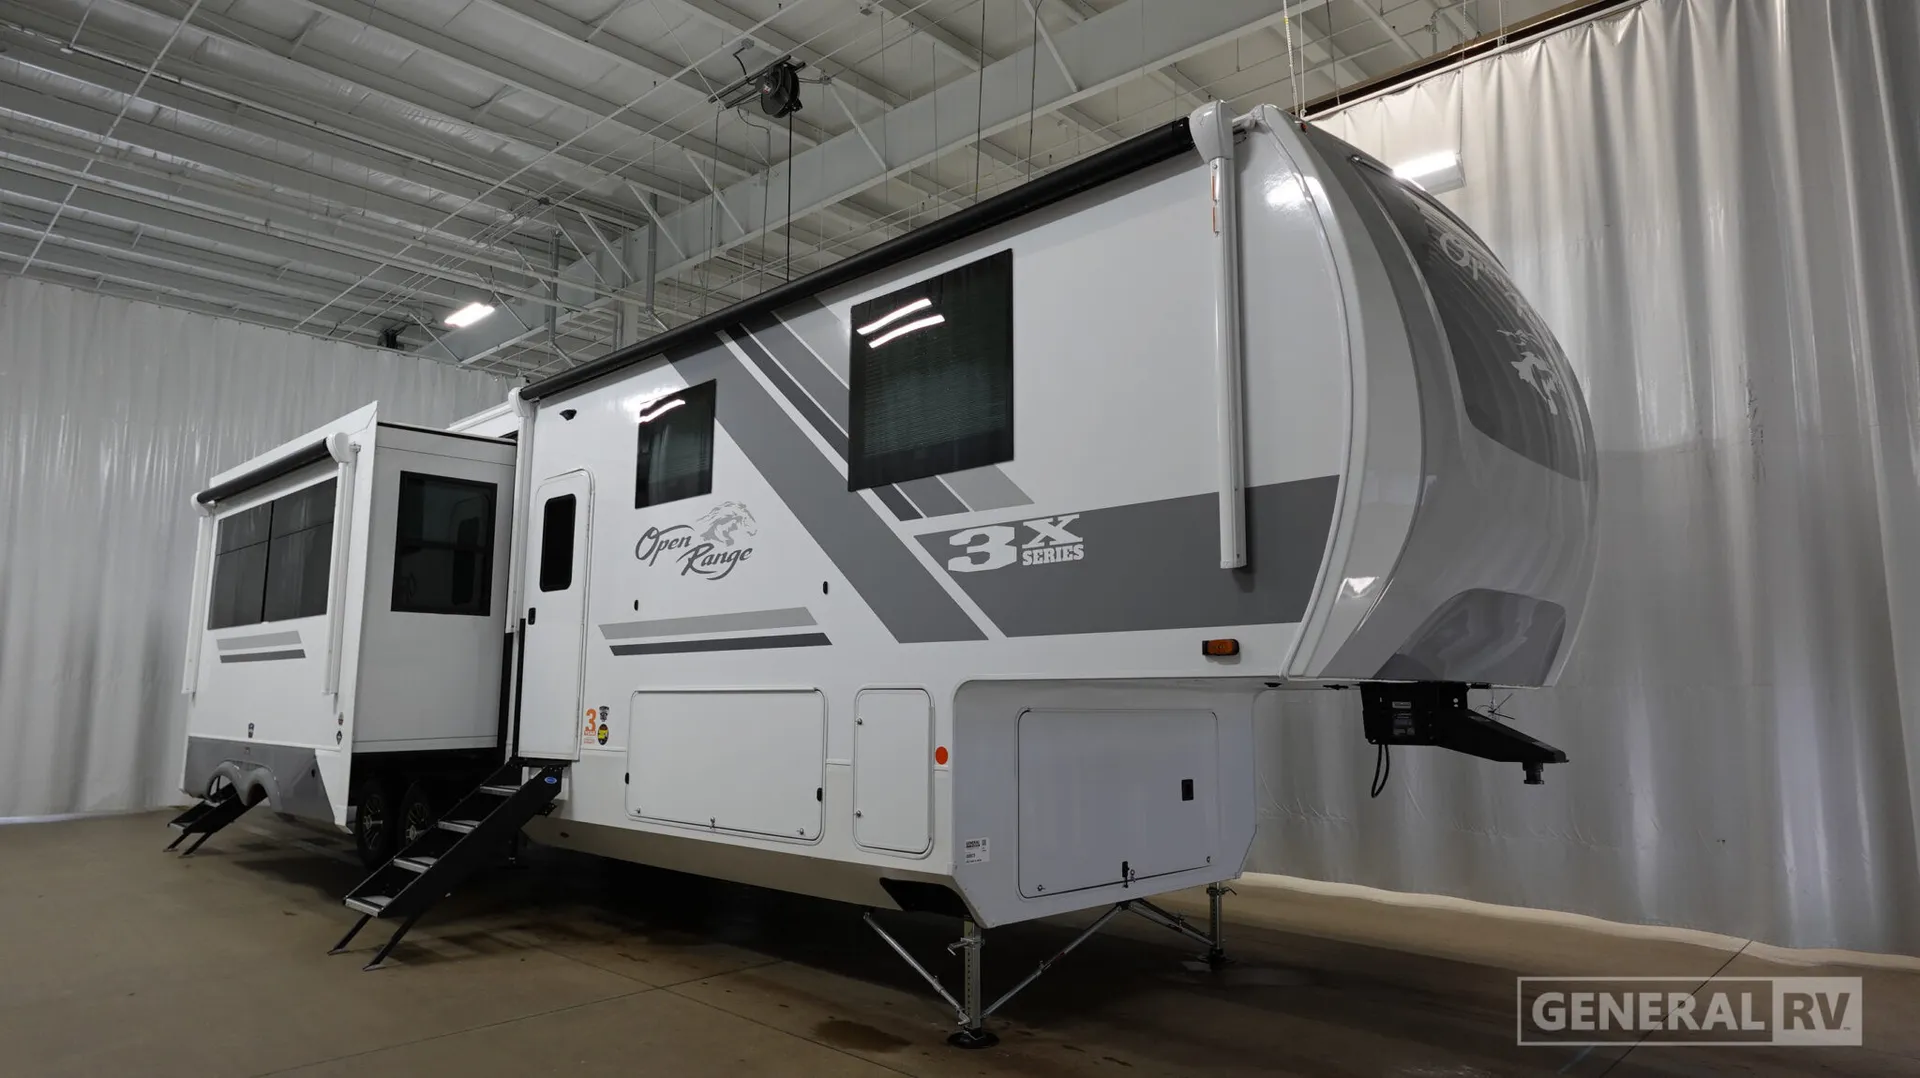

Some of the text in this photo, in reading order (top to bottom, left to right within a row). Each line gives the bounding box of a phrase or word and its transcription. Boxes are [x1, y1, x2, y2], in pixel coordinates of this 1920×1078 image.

[635, 524, 695, 567] Open
[1022, 544, 1084, 566] SERIES
[676, 542, 753, 581] Range
[585, 708, 597, 732] 3
